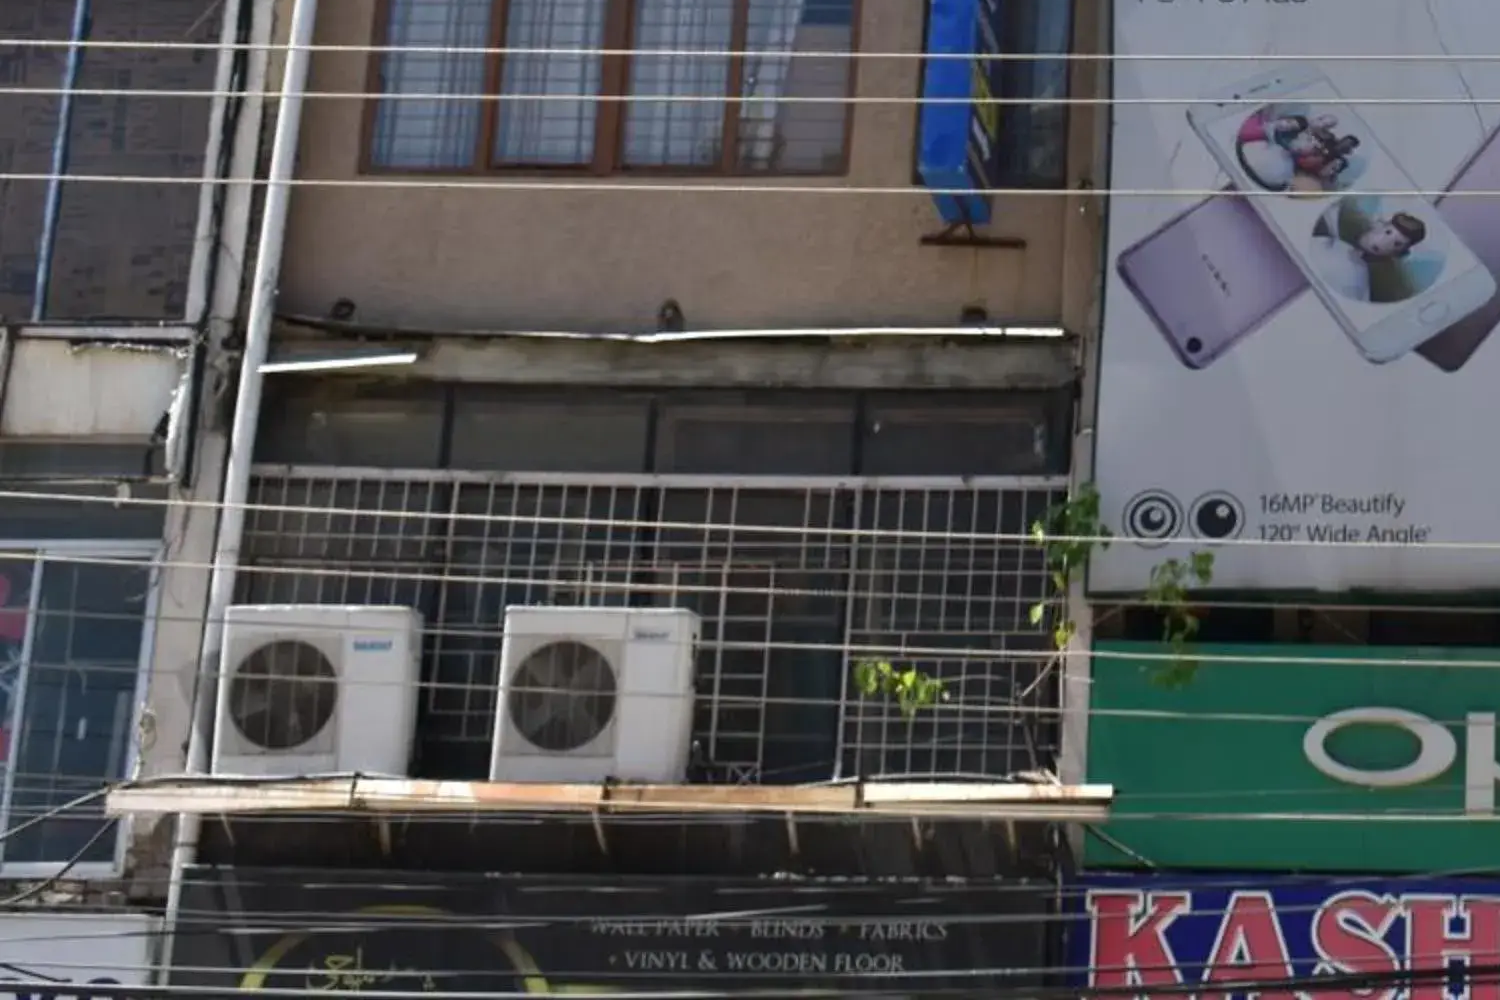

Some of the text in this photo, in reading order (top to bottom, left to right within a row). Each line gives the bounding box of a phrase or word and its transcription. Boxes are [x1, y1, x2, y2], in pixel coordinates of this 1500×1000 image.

[1321, 493, 1405, 518] Beautify
[1306, 524, 1361, 543] Wide
[751, 917, 826, 939] BLINDS
[860, 919, 949, 941] FABRICS
[624, 951, 907, 975] VINYL & WOODEN FLOOR
